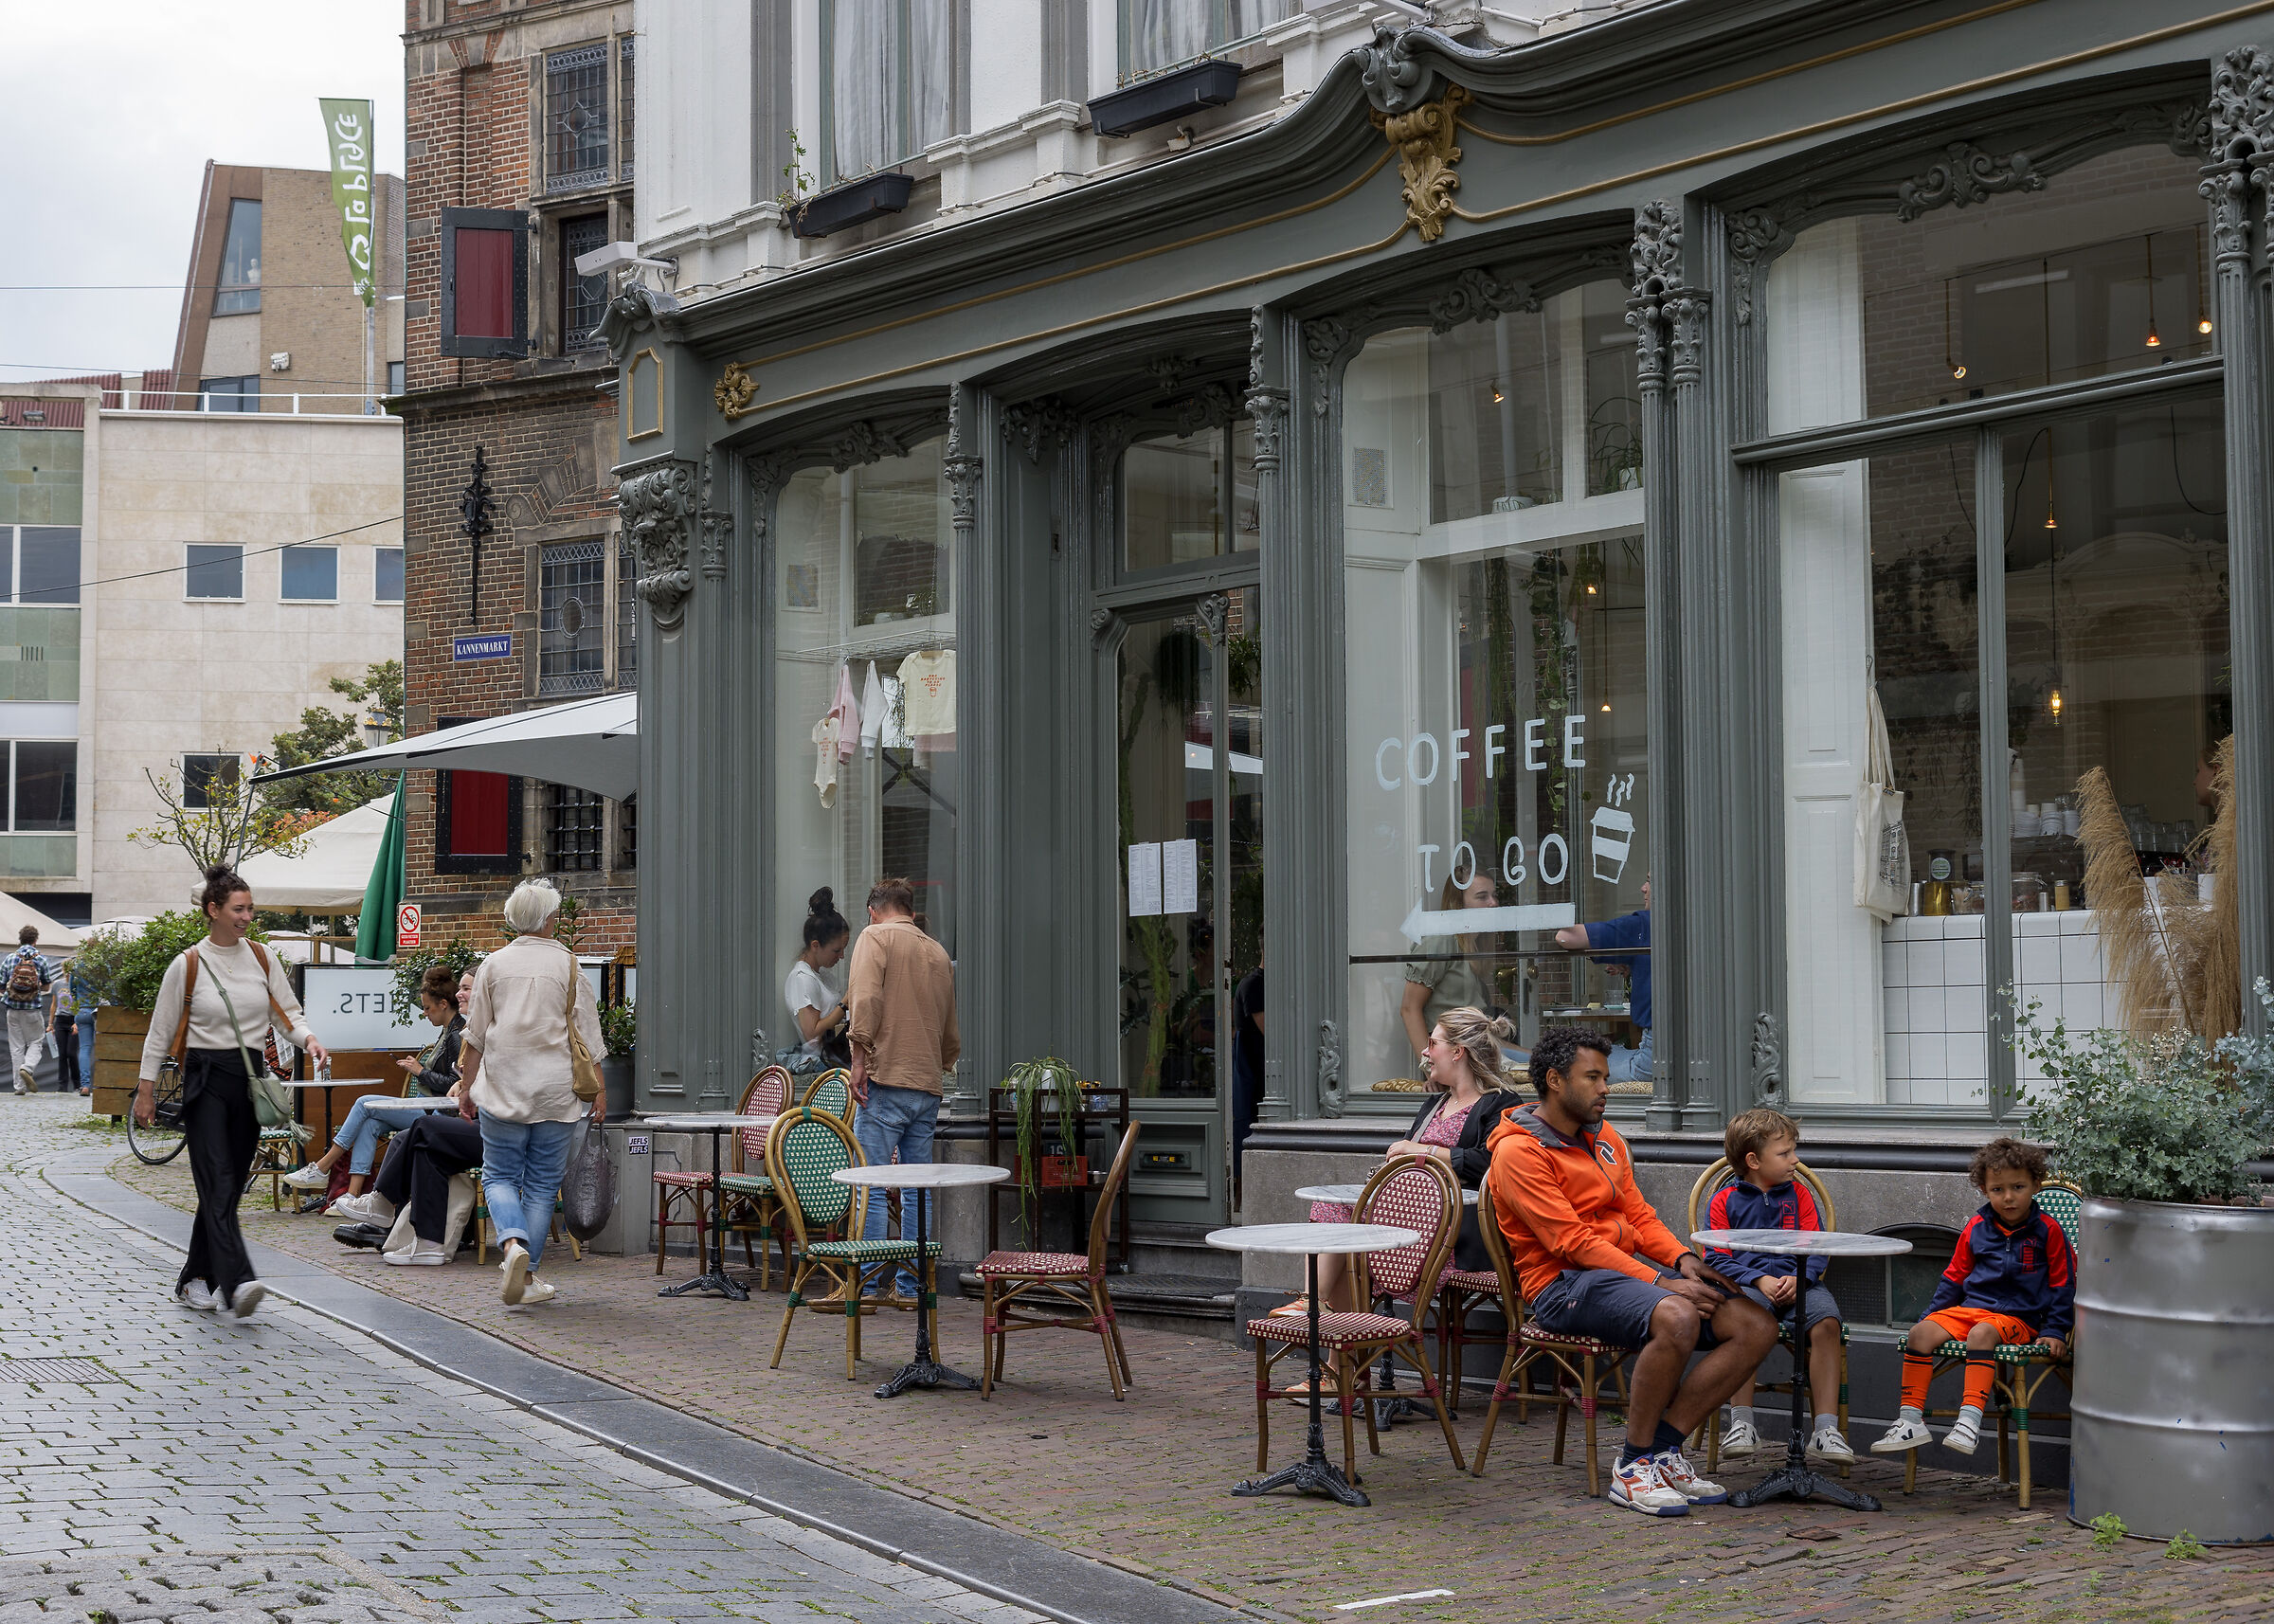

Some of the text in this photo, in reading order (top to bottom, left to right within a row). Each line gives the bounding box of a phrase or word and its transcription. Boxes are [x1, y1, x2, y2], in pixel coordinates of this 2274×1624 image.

[457, 641, 508, 656] KANNENMARKT
[1376, 714, 1586, 791] COFFEE
[1417, 833, 1568, 893] TO GO
[629, 1137, 648, 1146] JEFLS
[629, 1146, 648, 1154] JEFLS
